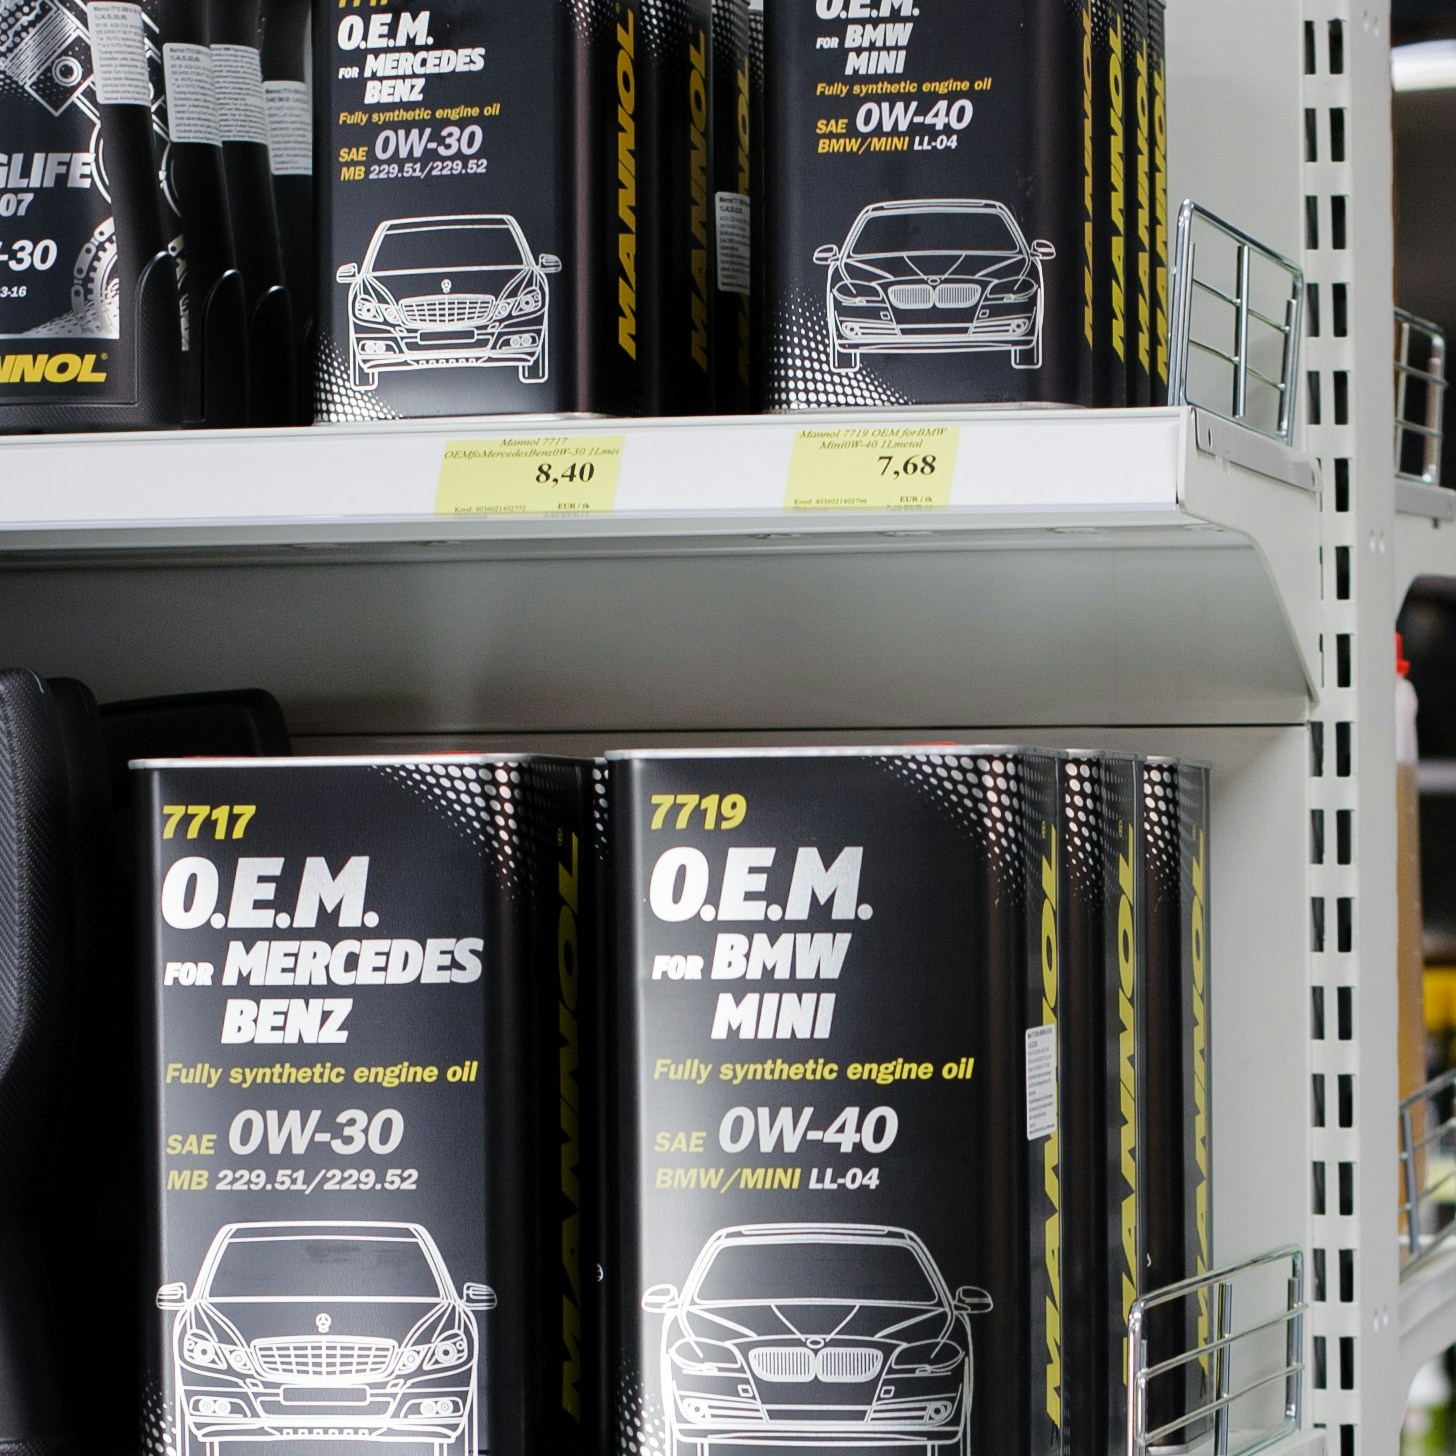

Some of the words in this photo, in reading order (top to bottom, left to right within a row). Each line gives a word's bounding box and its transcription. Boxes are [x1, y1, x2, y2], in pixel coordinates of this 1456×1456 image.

[337, 10, 434, 50] O.E.M.
[816, 37, 839, 49] FOR
[844, 22, 913, 48] BMW
[338, 66, 359, 79] FOR
[364, 47, 486, 78] MERCEDES
[845, 50, 906, 75] MINI
[364, 77, 425, 104] BENZ
[816, 119, 848, 134] SAE
[856, 99, 974, 133] 0W-40
[339, 147, 368, 162] SAE
[374, 124, 483, 161] 0W-30
[818, 136, 910, 155] BMW/MINI
[913, 134, 958, 150] LL-04
[340, 166, 365, 181] MB
[368, 158, 488, 180] 229.51/229.52
[617, 8, 636, 360] MANNOL
[800, 429, 840, 439] Mannol
[844, 429, 870, 438] 7719
[871, 428, 900, 438] OEM
[820, 440, 879, 450] Mini0W-40
[535, 462, 595, 488] 8,40
[878, 454, 936, 480] 7,68
[162, 805, 256, 840] 7717
[651, 793, 747, 830] 7719
[161, 856, 379, 929] O.E.M.
[650, 846, 874, 922] O.E.M.
[163, 961, 215, 986] FOR
[222, 936, 484, 986] MERCEDES
[651, 954, 704, 980] FOR
[710, 932, 852, 980] BMW
[221, 998, 354, 1044] BENZ
[710, 992, 836, 1039] MINI
[166, 1062, 223, 1088] Fully
[229, 1062, 345, 1088] synthetic
[353, 1061, 438, 1087] engine
[446, 1060, 479, 1083] oil
[653, 1058, 713, 1085] Fully
[719, 1058, 839, 1085] synthetic
[846, 1057, 934, 1085] engine
[941, 1057, 975, 1080] oil
[166, 1134, 217, 1155] SAE
[228, 1108, 404, 1156] 0W-30
[558, 833, 581, 1423] MANNOL
[654, 1131, 707, 1152] SAE
[718, 1105, 899, 1154] 0W-40
[166, 1170, 209, 1190] MB
[215, 1168, 418, 1195] 229.51/229.52
[654, 1167, 801, 1194] BMW/MINI
[808, 1167, 880, 1190] LL-04
